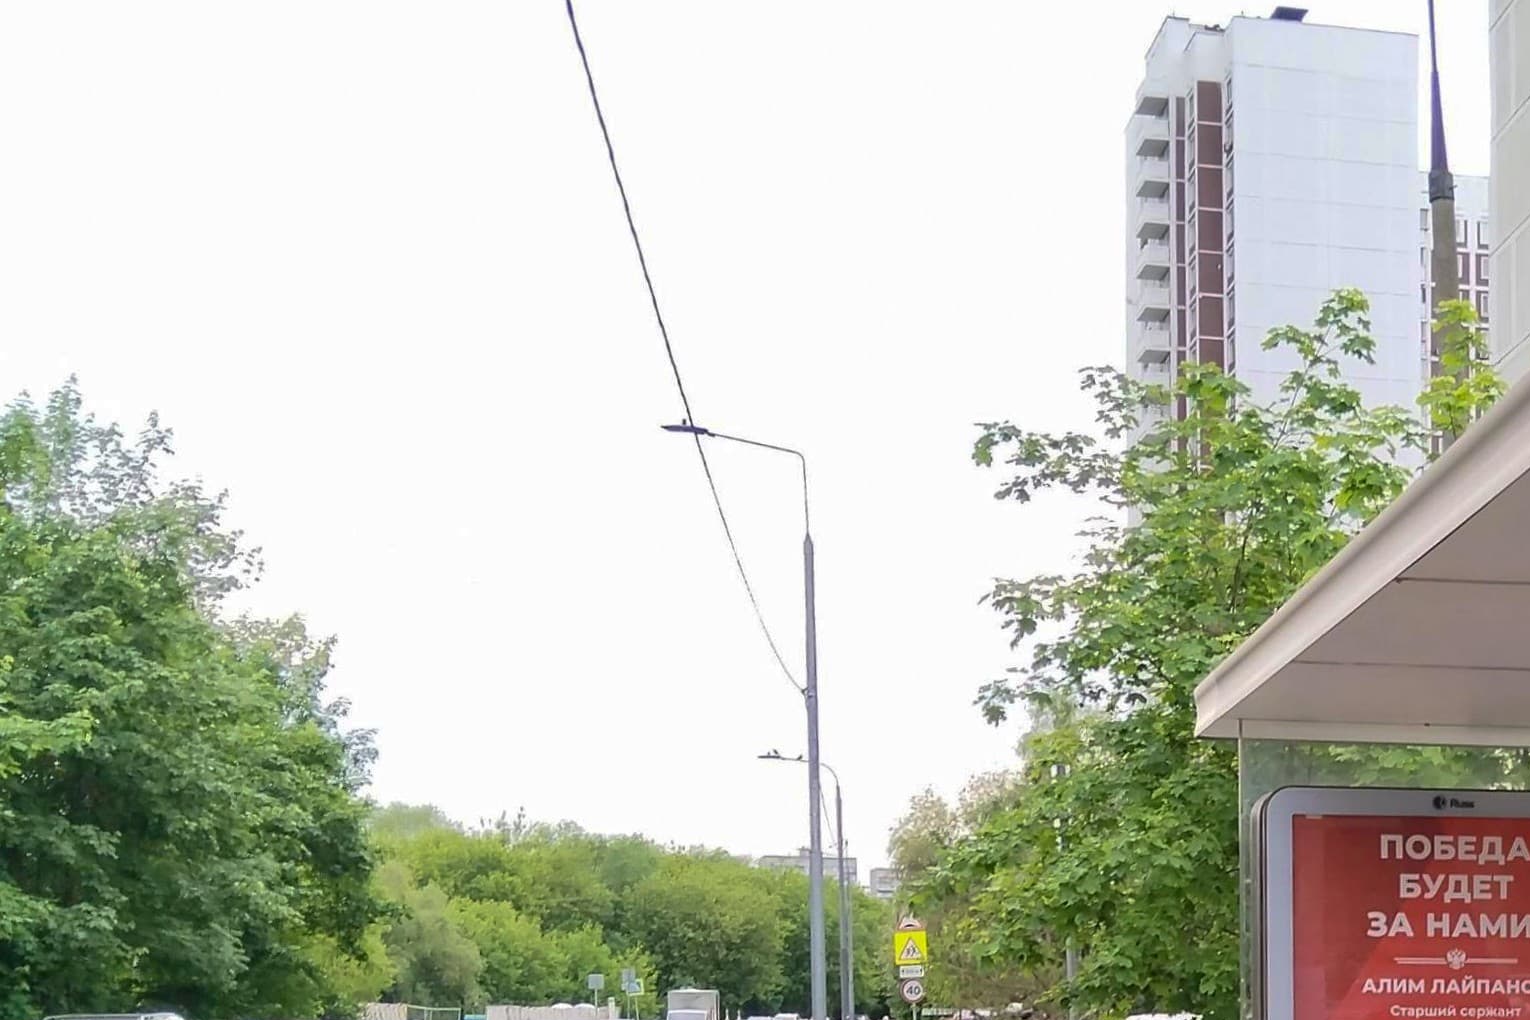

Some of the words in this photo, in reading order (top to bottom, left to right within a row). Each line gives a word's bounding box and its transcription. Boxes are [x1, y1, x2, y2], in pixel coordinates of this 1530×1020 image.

[1399, 873, 1514, 903] БУДЕТ
[1367, 911, 1414, 938] ЗА
[906, 985, 921, 995] 40
[1361, 977, 1426, 995] АЛИМ
[1389, 1004, 1457, 1019] Старший
[1460, 1006, 1522, 1019] сержант
